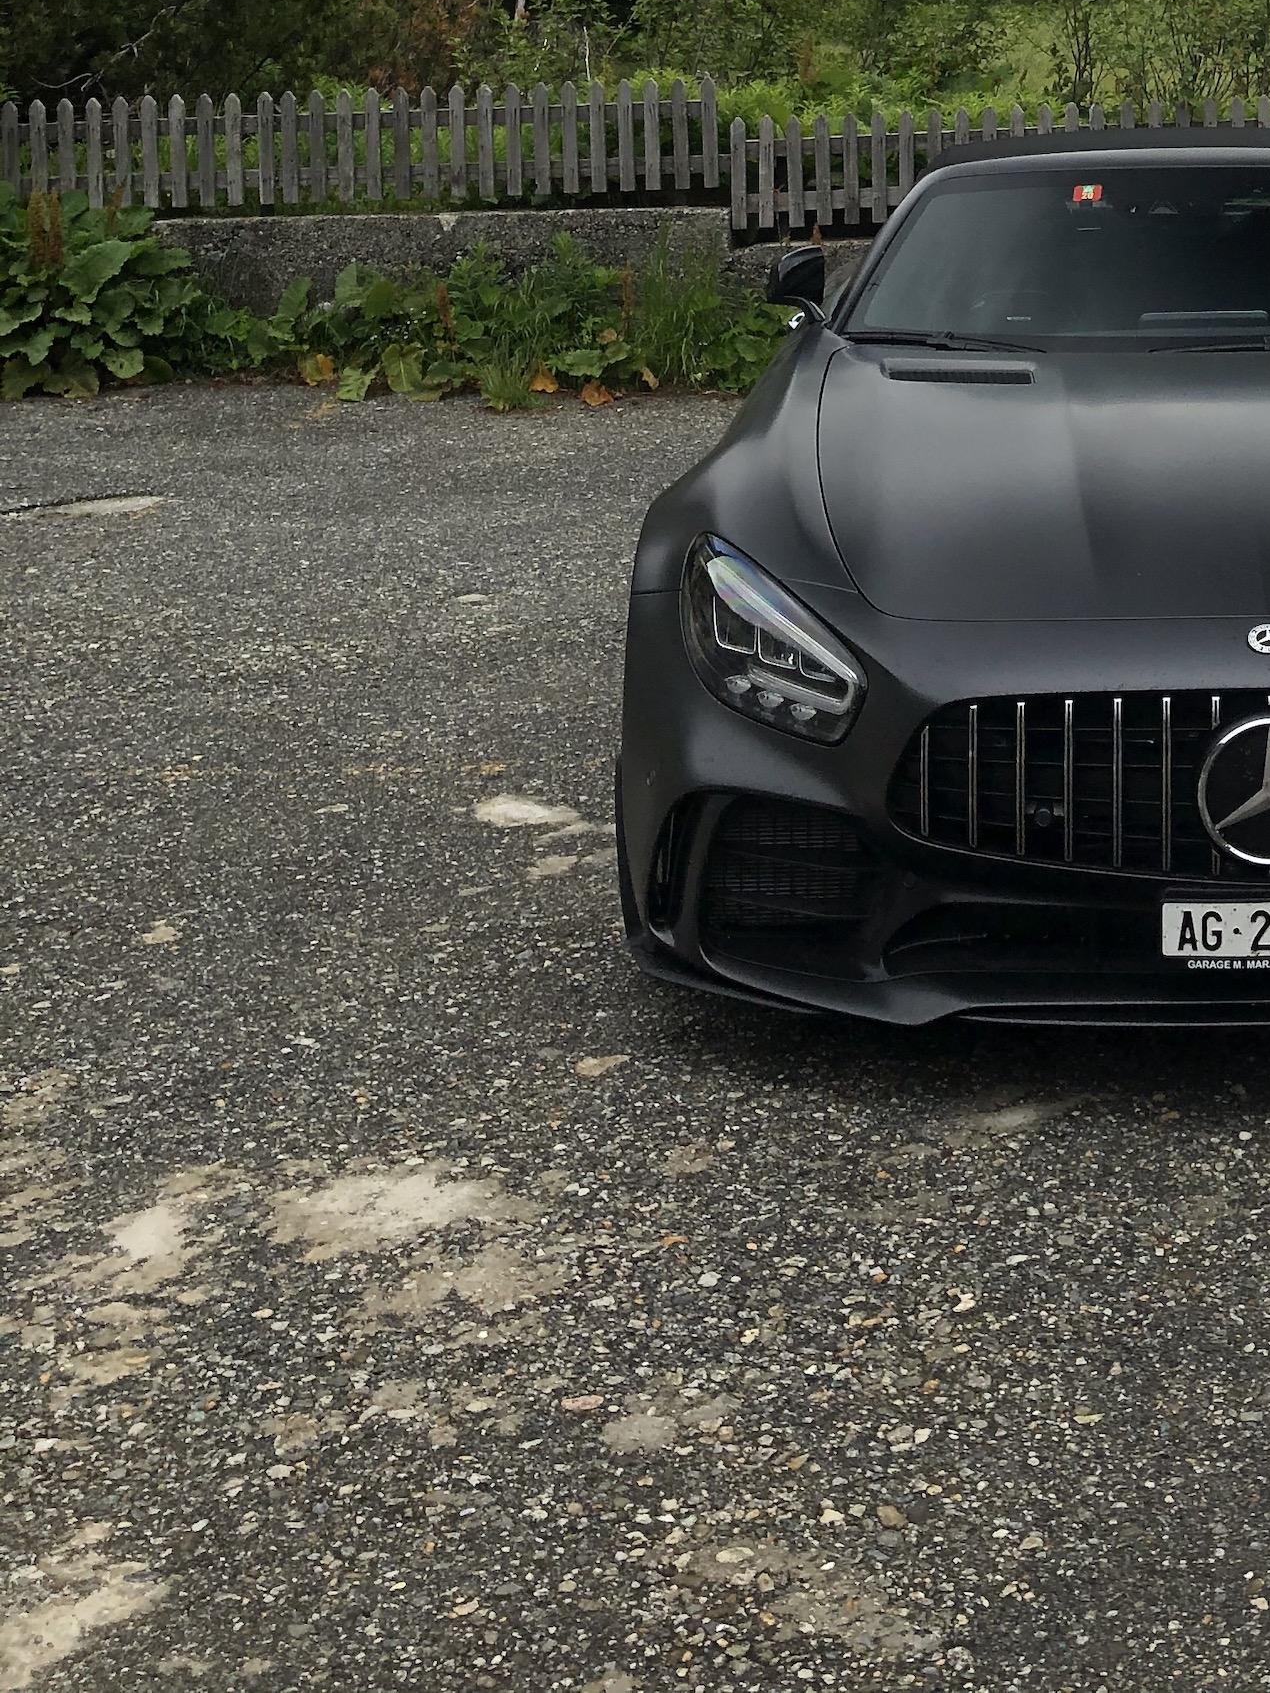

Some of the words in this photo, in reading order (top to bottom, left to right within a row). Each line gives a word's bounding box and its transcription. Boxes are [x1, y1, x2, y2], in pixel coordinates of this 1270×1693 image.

[1178, 910, 1223, 951] AG
[1187, 959, 1231, 970] GARAGE
[1232, 959, 1245, 969] M.
